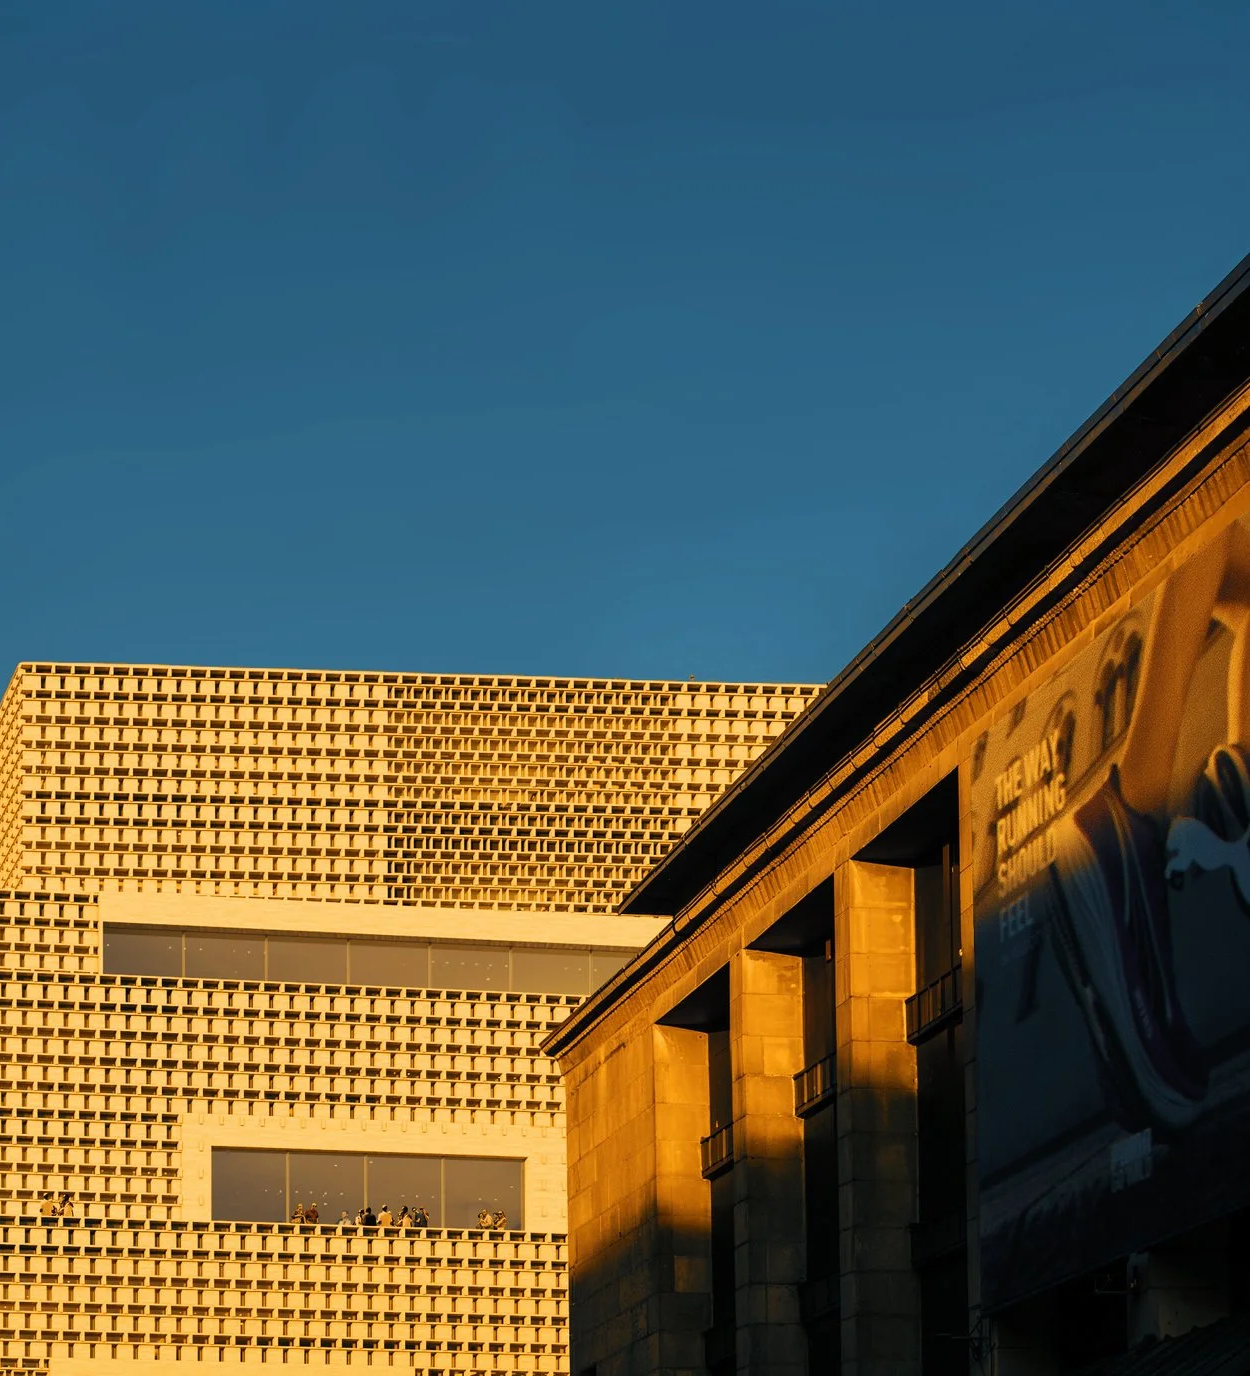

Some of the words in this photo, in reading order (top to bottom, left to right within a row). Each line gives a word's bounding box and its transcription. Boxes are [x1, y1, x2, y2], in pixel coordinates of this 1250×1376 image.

[995, 757, 1022, 811] THE
[1023, 728, 1060, 789] WAY
[997, 773, 1066, 862] RUNNING
[998, 830, 1055, 898] SHOULD
[1000, 891, 1034, 942] FEEL
